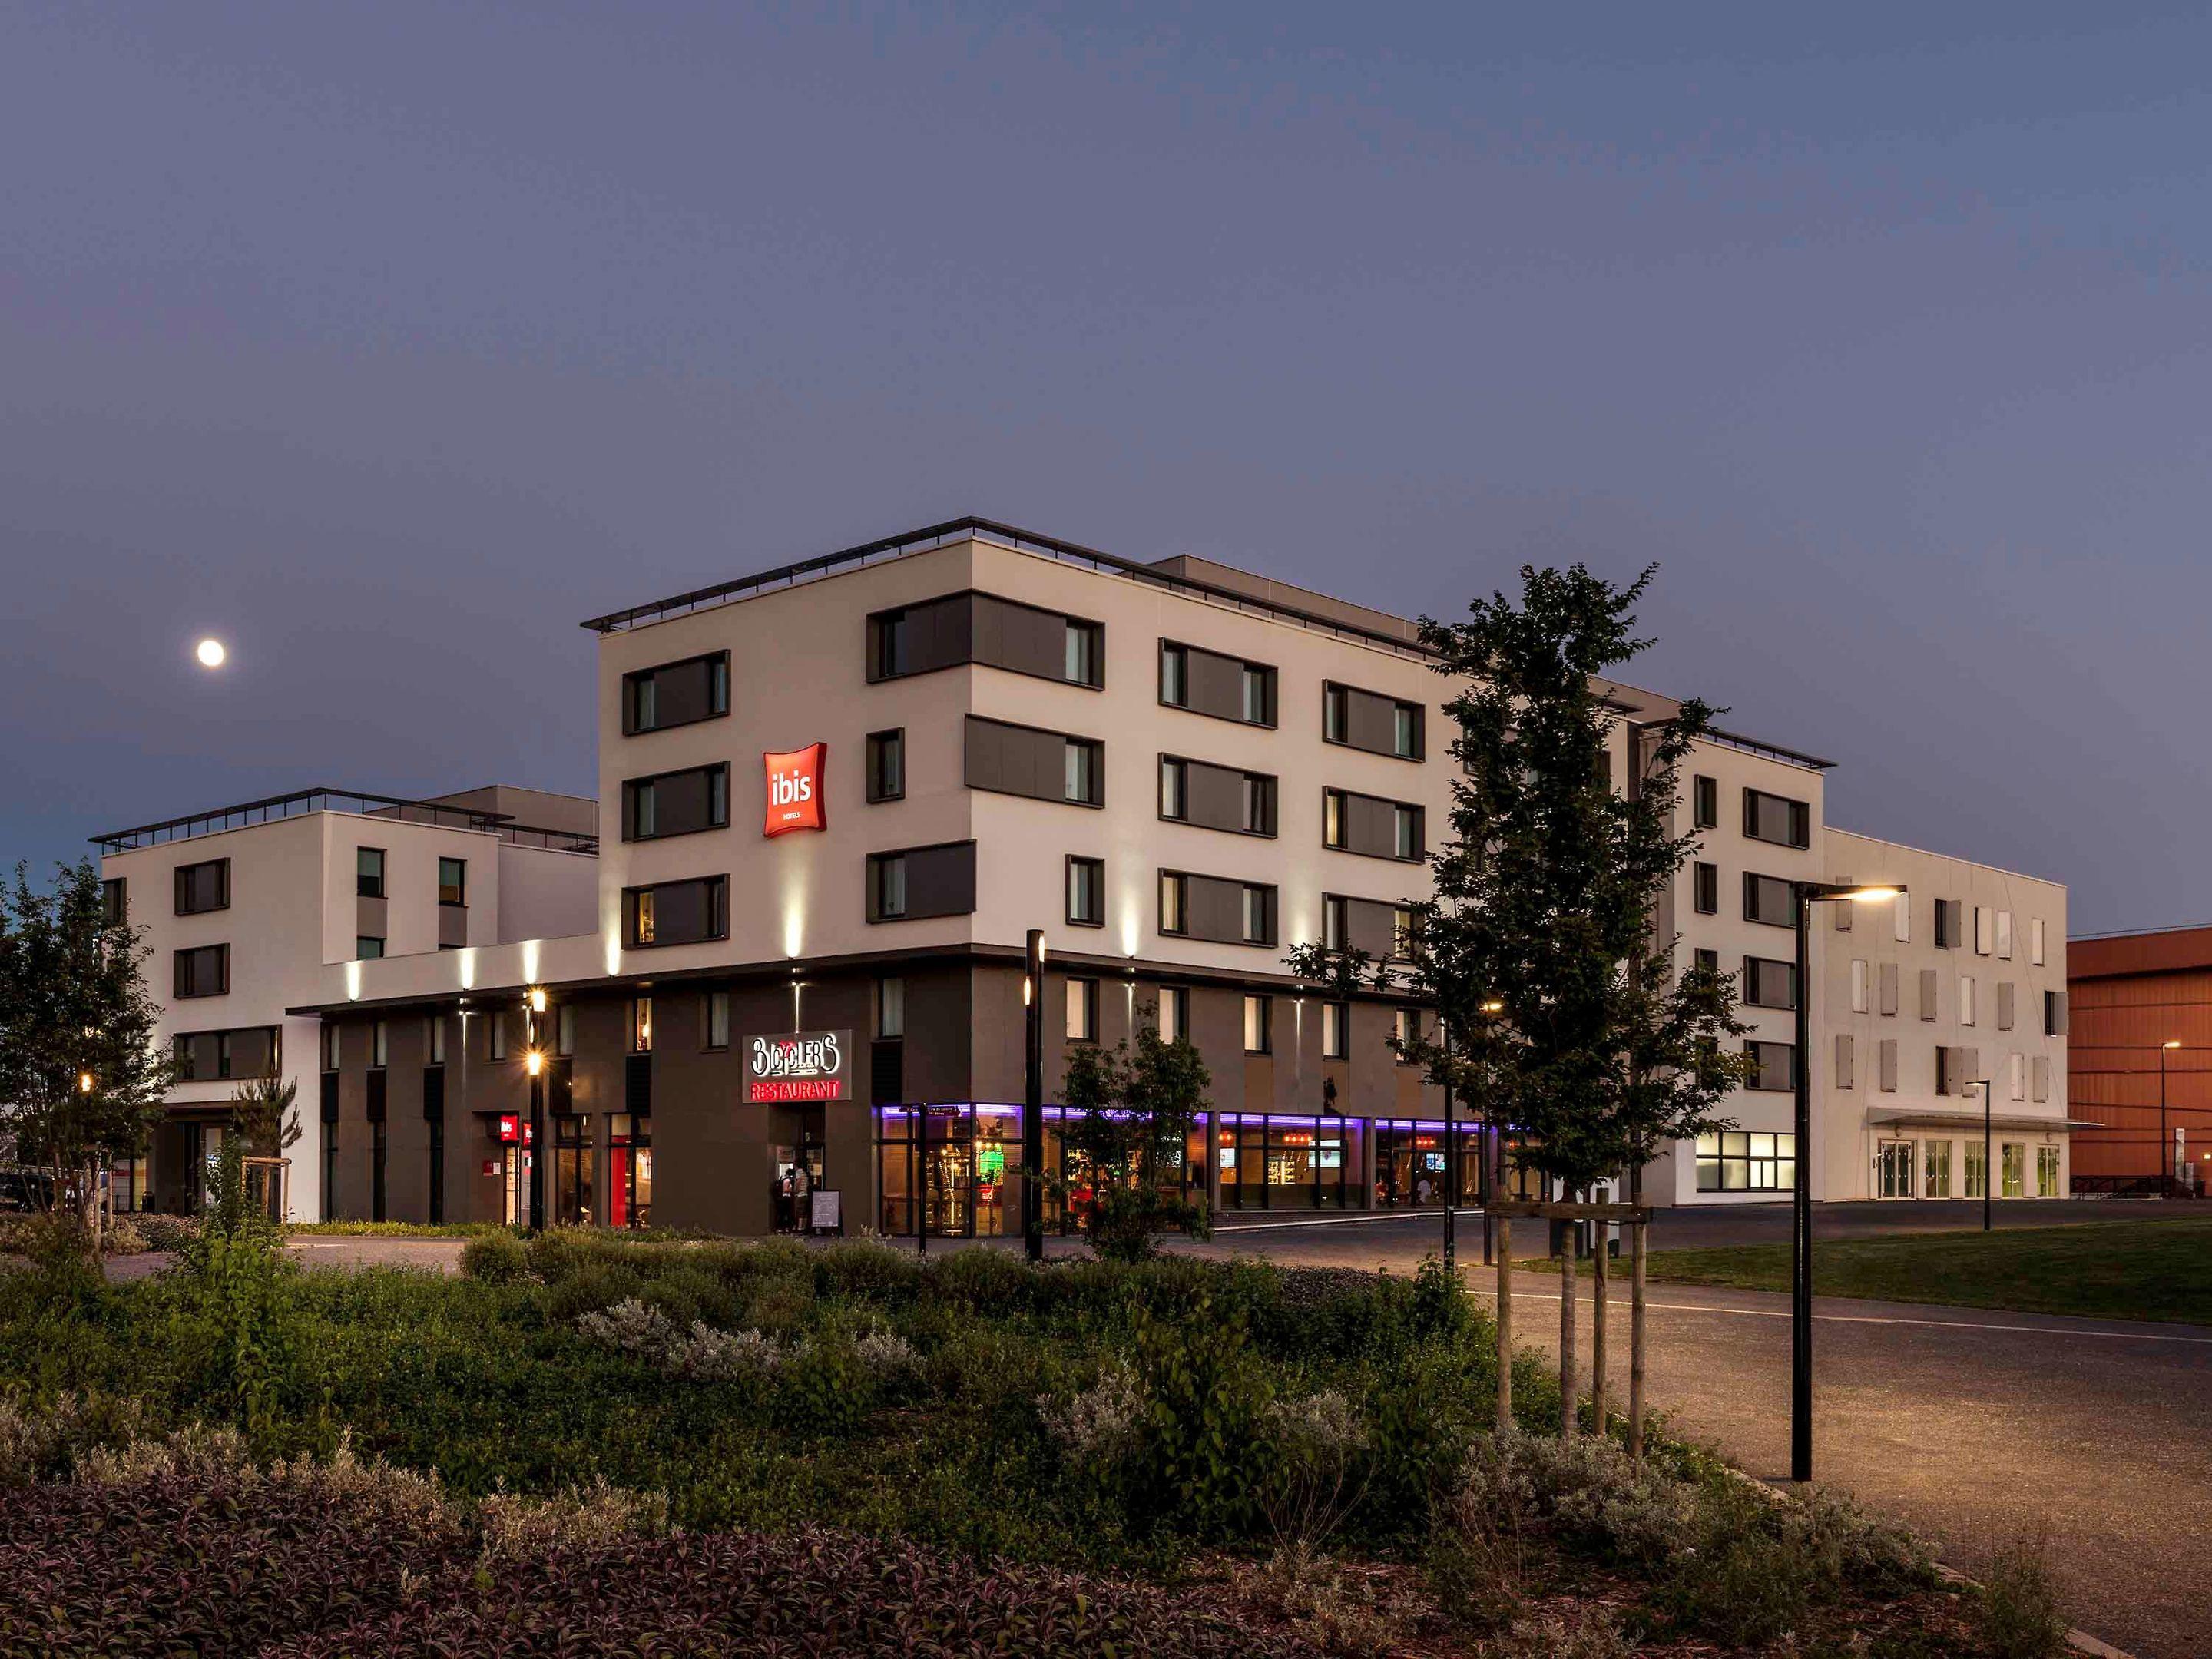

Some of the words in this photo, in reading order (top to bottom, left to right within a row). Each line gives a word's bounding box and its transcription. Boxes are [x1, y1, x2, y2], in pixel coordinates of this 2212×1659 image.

[772, 769, 811, 806] ibis
[783, 812, 800, 820] HOTELS
[750, 1079, 840, 1101] RESTAURANT
